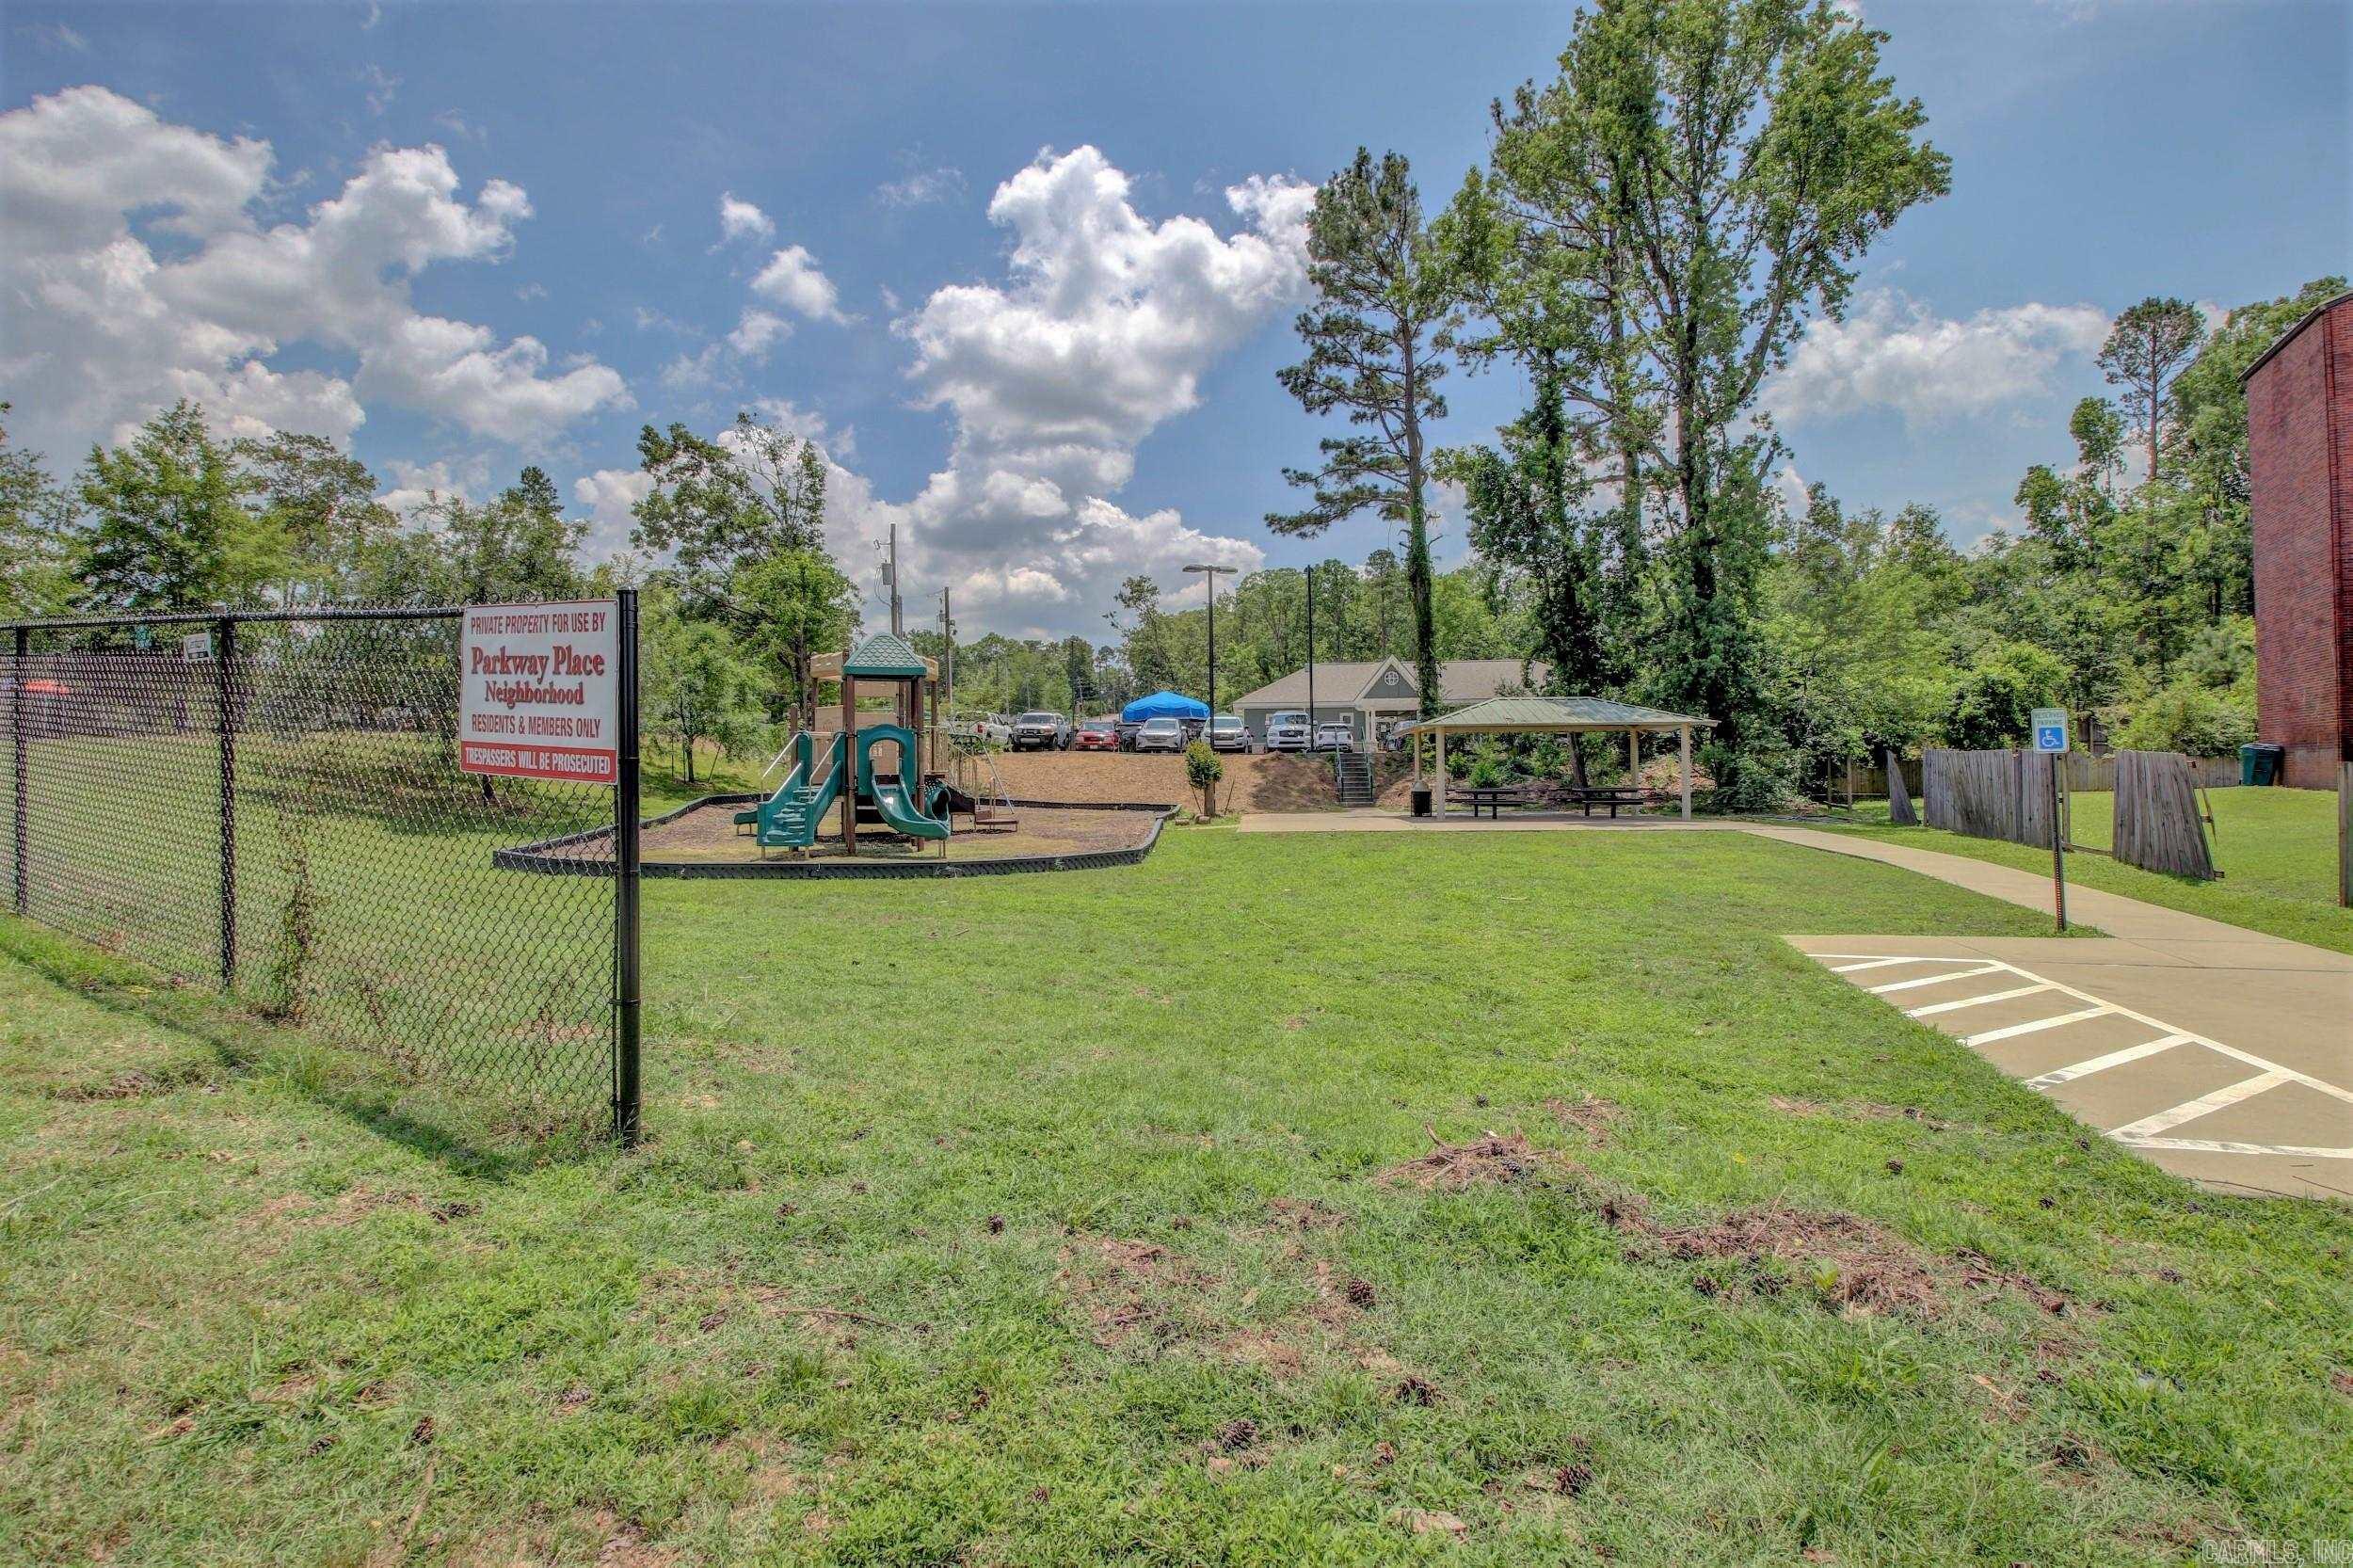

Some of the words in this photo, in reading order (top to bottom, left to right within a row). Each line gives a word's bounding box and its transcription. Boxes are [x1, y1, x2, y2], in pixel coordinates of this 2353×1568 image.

[471, 616, 503, 634] PRIVATE
[505, 614, 549, 633] PROPERTY
[552, 614, 568, 633] FOR
[572, 613, 588, 632] USE
[592, 612, 605, 632] BY
[471, 645, 550, 684] Parkway
[552, 645, 604, 677] Place
[485, 680, 584, 710] Neighborhood
[472, 713, 516, 734] RESIDENTS
[519, 716, 525, 734] &
[529, 716, 572, 737] MEMBERS
[576, 718, 600, 738] ONLY
[466, 746, 517, 768] TRESPASSERS
[518, 750, 537, 770] WILL
[539, 753, 551, 771] BE
[552, 754, 610, 775] PROSECUTED
